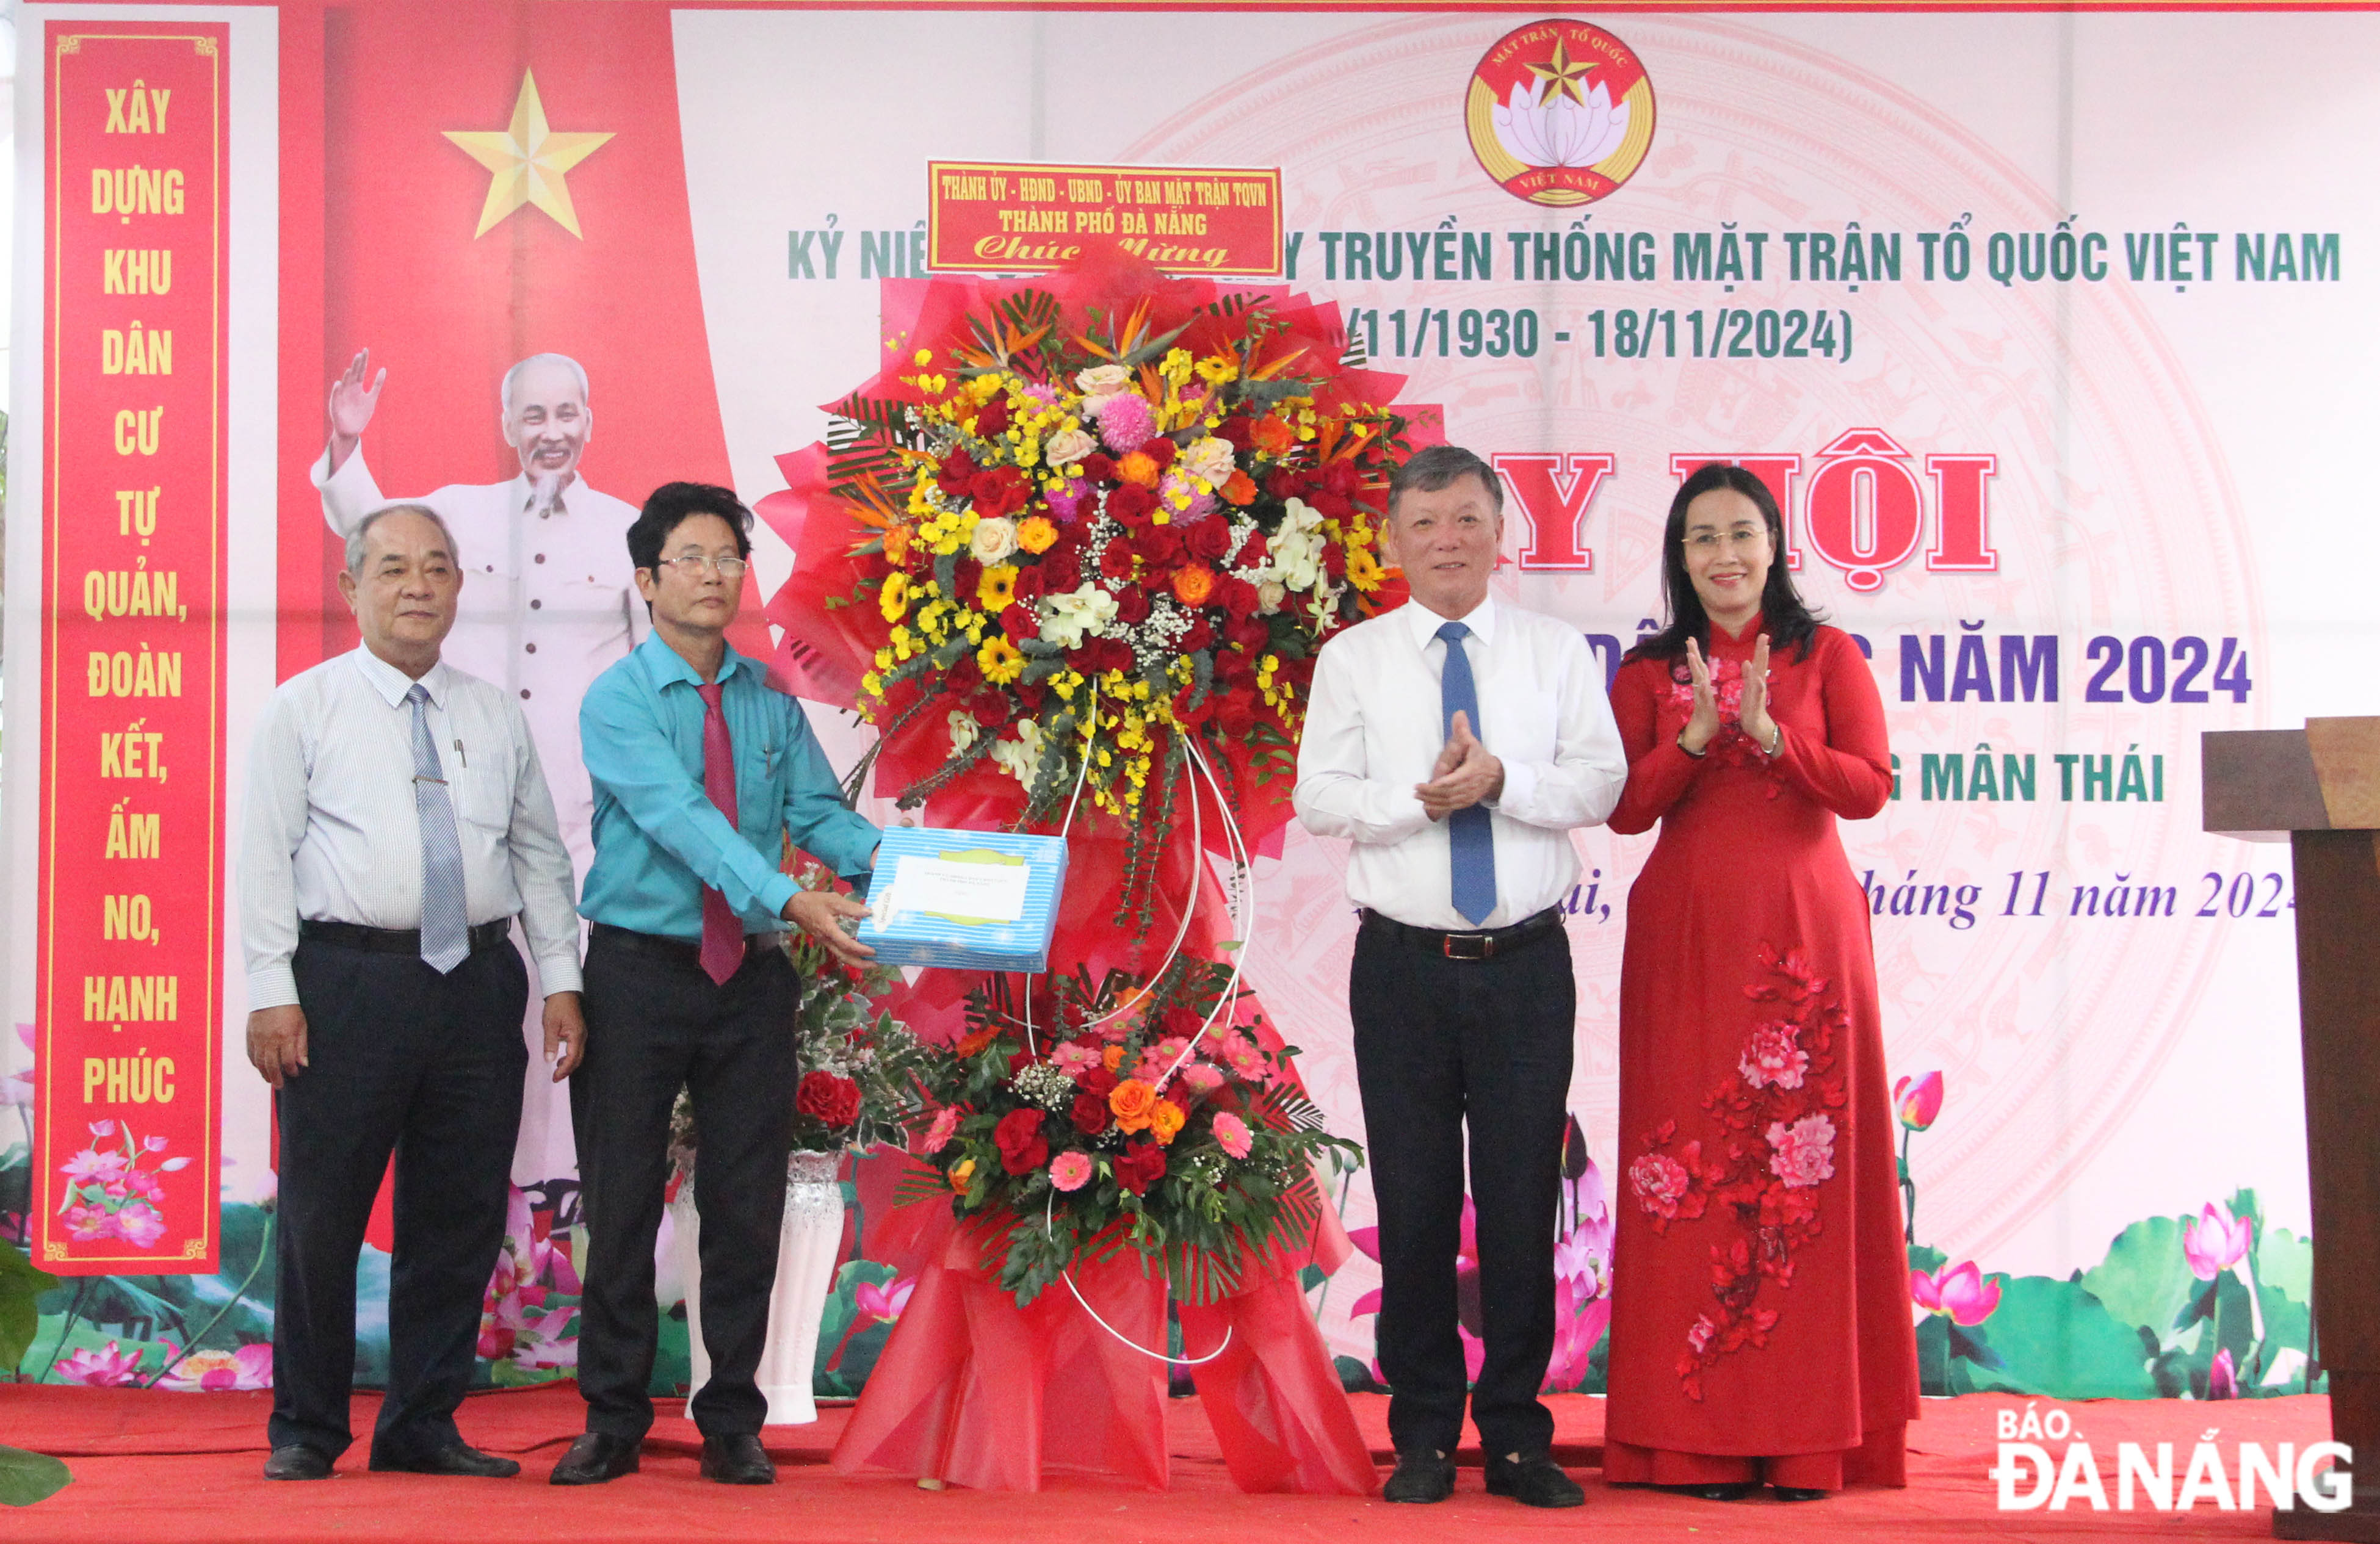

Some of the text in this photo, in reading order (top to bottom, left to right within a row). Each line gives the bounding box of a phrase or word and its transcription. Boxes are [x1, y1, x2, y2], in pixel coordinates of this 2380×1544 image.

[1522, 26, 1558, 45] TRẬN
[1569, 28, 1589, 42] TỔ
[1591, 37, 1629, 69] QUỐC
[104, 80, 172, 134] XÂY
[92, 165, 184, 225] DỰNG
[942, 170, 987, 201] THÀNH
[990, 170, 1007, 201] ỦY
[1019, 177, 1056, 202] HĐND
[1068, 178, 1104, 203] UBND
[1115, 173, 1132, 204] ỦY
[1135, 181, 1161, 204] BAN
[1163, 178, 1192, 209] MẶT
[1195, 178, 1229, 210] TRẬN
[1232, 182, 1267, 208] TQVN
[1519, 172, 1599, 191] VIỆT NAM
[788, 213, 845, 280] KỶ
[974, 235, 1081, 260] Chúc
[999, 205, 1207, 236] THÀNH PHỐ ĐÀ NẴNG
[104, 249, 172, 295] KHU
[1320, 215, 1491, 281] TRUYỀN
[1507, 212, 1655, 281] THỐNG
[1674, 221, 1770, 292] MẶT
[1784, 222, 1901, 293] TRẬN
[1917, 212, 1972, 281] TỔ
[1988, 214, 2108, 287] QUỐC
[2125, 222, 2220, 293] VIỆT
[2235, 233, 2341, 282] NAM
[102, 320, 173, 375] DÂN
[1555, 330, 1571, 342] -
[1587, 308, 1853, 364] 18/11/2024)
[115, 406, 164, 456] CƯ
[116, 486, 161, 546] TỰ
[84, 556, 187, 622] QUẢN,
[87, 643, 182, 698] ĐOÀN
[1899, 619, 2252, 704] NĂM 2024
[101, 718, 167, 784] KẾT,
[1921, 743, 2036, 802] MÂN
[2053, 743, 2164, 803] THÁI
[106, 797, 160, 859] ẤM
[104, 895, 160, 946] NO,
[1998, 871, 2050, 916] 11
[2069, 870, 2177, 917] năm
[84, 976, 178, 1032] HẠNH
[84, 1048, 175, 1104] PHÚC
